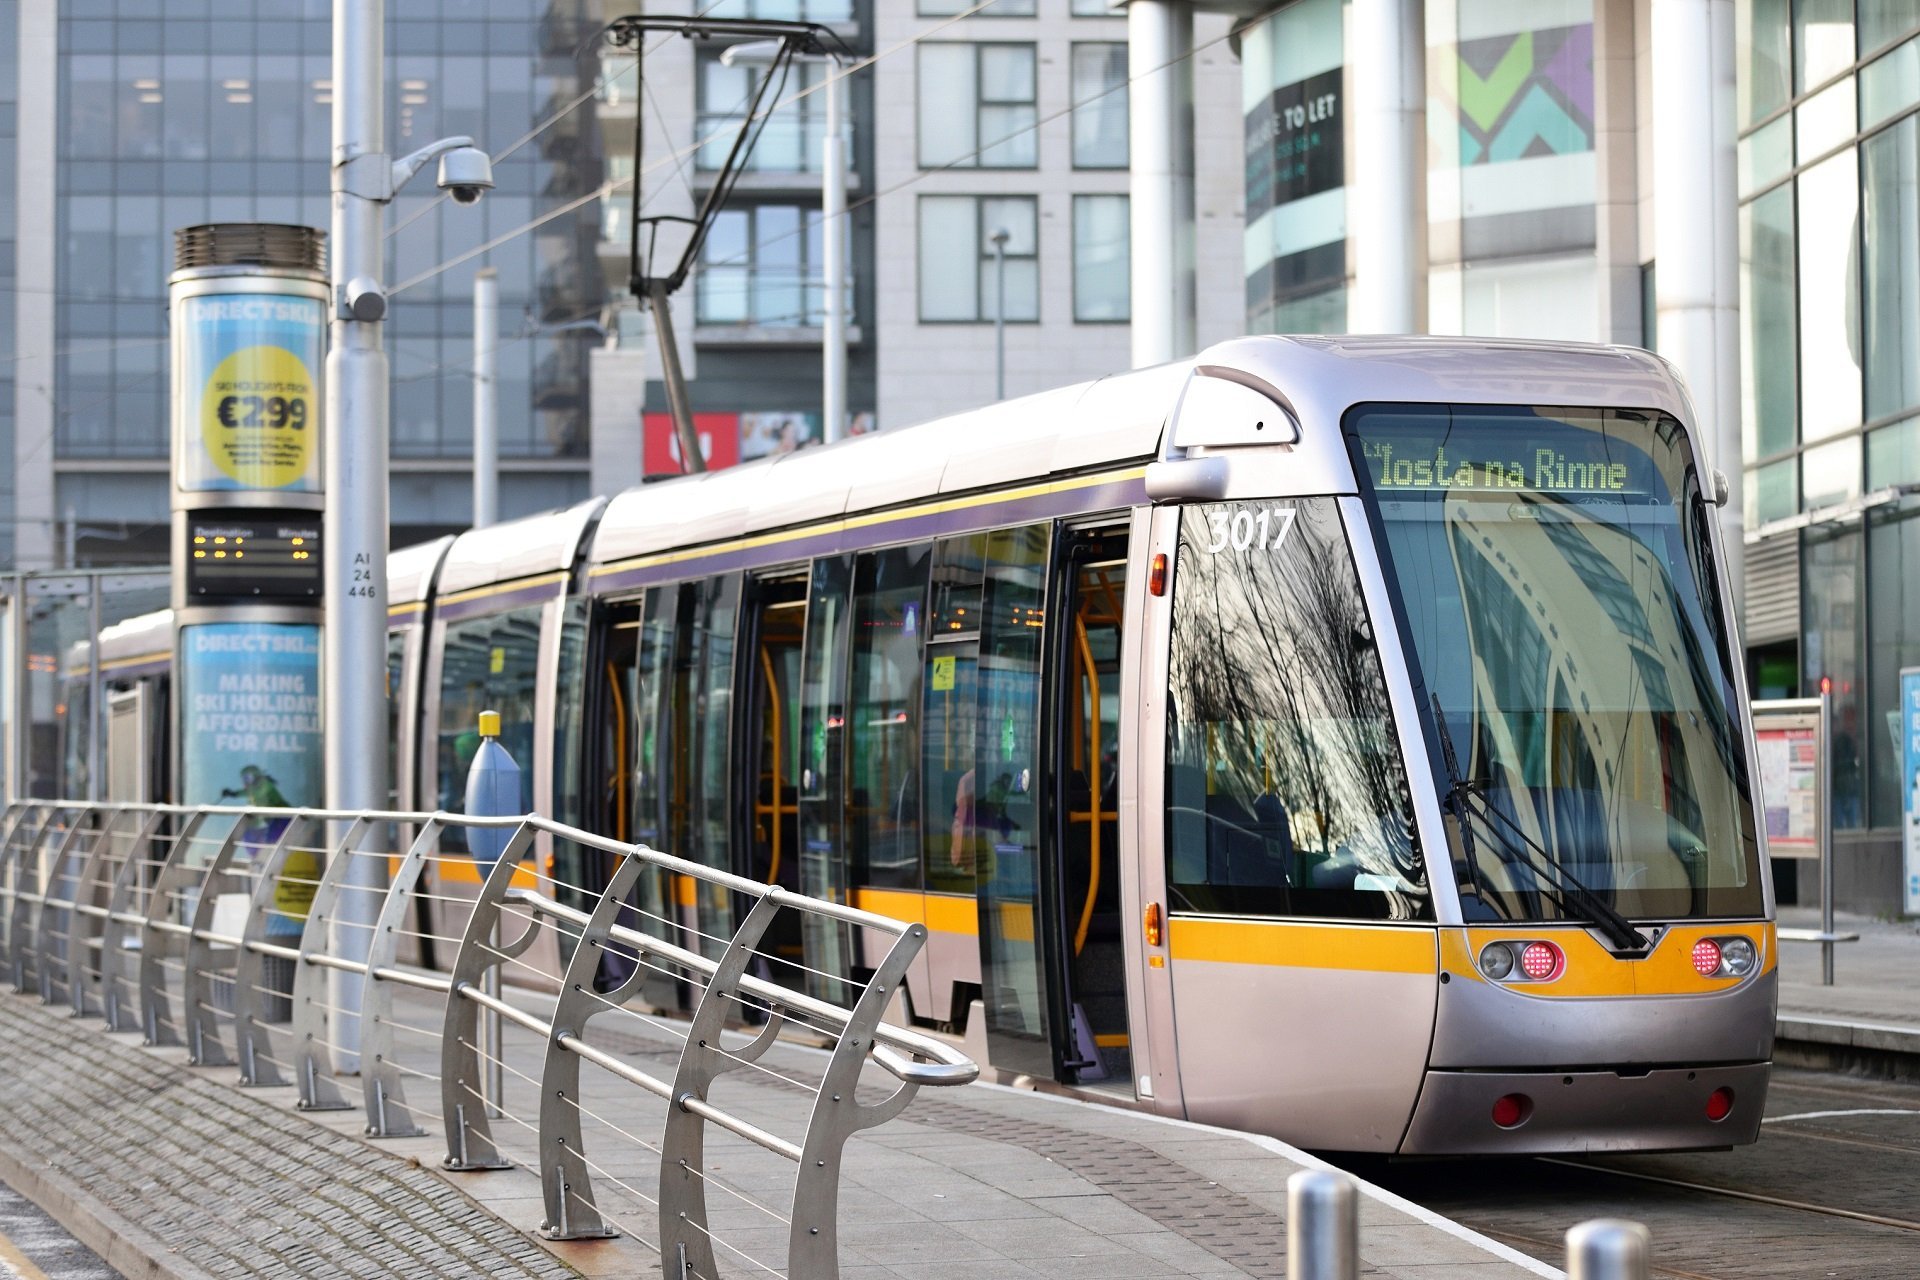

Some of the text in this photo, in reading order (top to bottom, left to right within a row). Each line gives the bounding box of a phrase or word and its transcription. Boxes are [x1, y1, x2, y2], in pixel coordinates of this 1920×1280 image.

[1284, 93, 1336, 131] TO LET
[217, 396, 307, 431] €299
[1485, 460, 1524, 488] na
[1535, 448, 1627, 489] Rinne
[195, 527, 319, 539] Destination Minutes
[1208, 508, 1297, 554] 3017
[353, 569, 371, 582] 24
[348, 586, 376, 598] 446
[218, 674, 305, 692] MAKING
[195, 693, 225, 712] SKI
[216, 733, 259, 751] FOR
